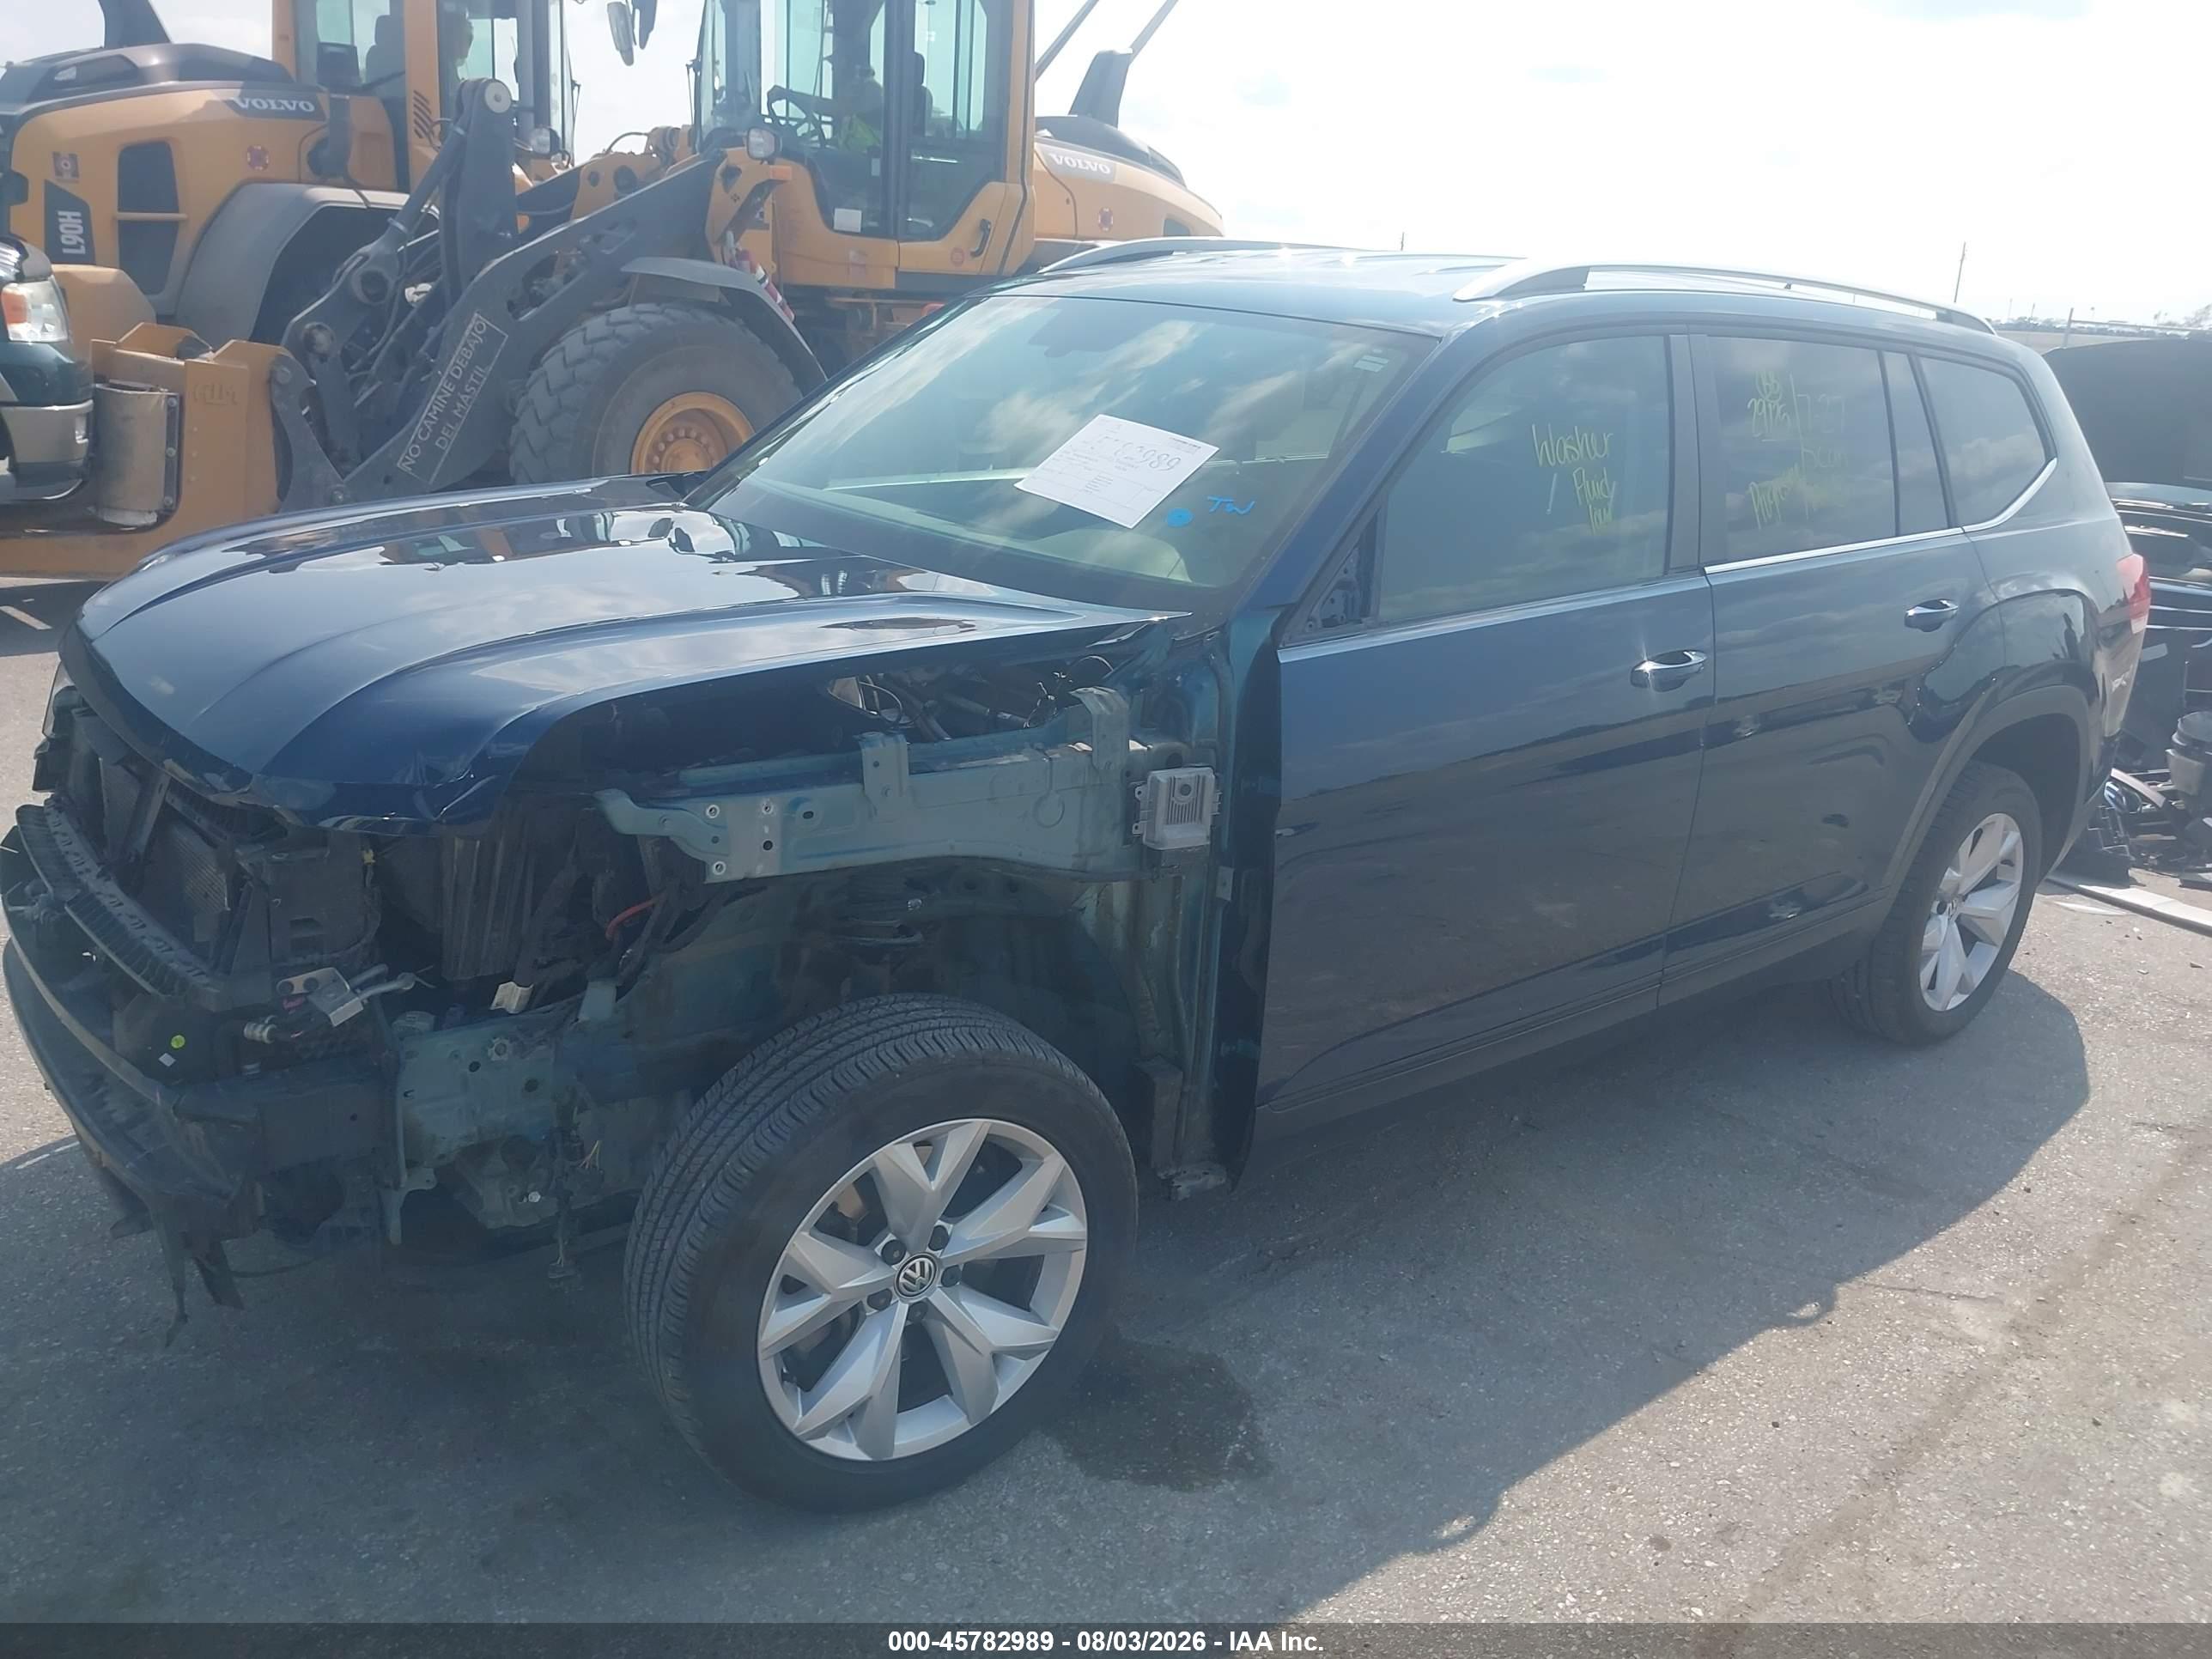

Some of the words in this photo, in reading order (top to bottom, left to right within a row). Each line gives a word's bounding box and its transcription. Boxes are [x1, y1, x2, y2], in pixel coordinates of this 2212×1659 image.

[234, 97, 315, 112] VOLVO
[1048, 153, 1111, 174] VOLVO
[57, 210, 86, 254] L90H
[401, 443, 422, 471] NO
[417, 379, 456, 441] CAMINE
[450, 320, 487, 380] DEBAJO
[434, 422, 459, 450] DEL
[1531, 422, 1613, 467] Washer
